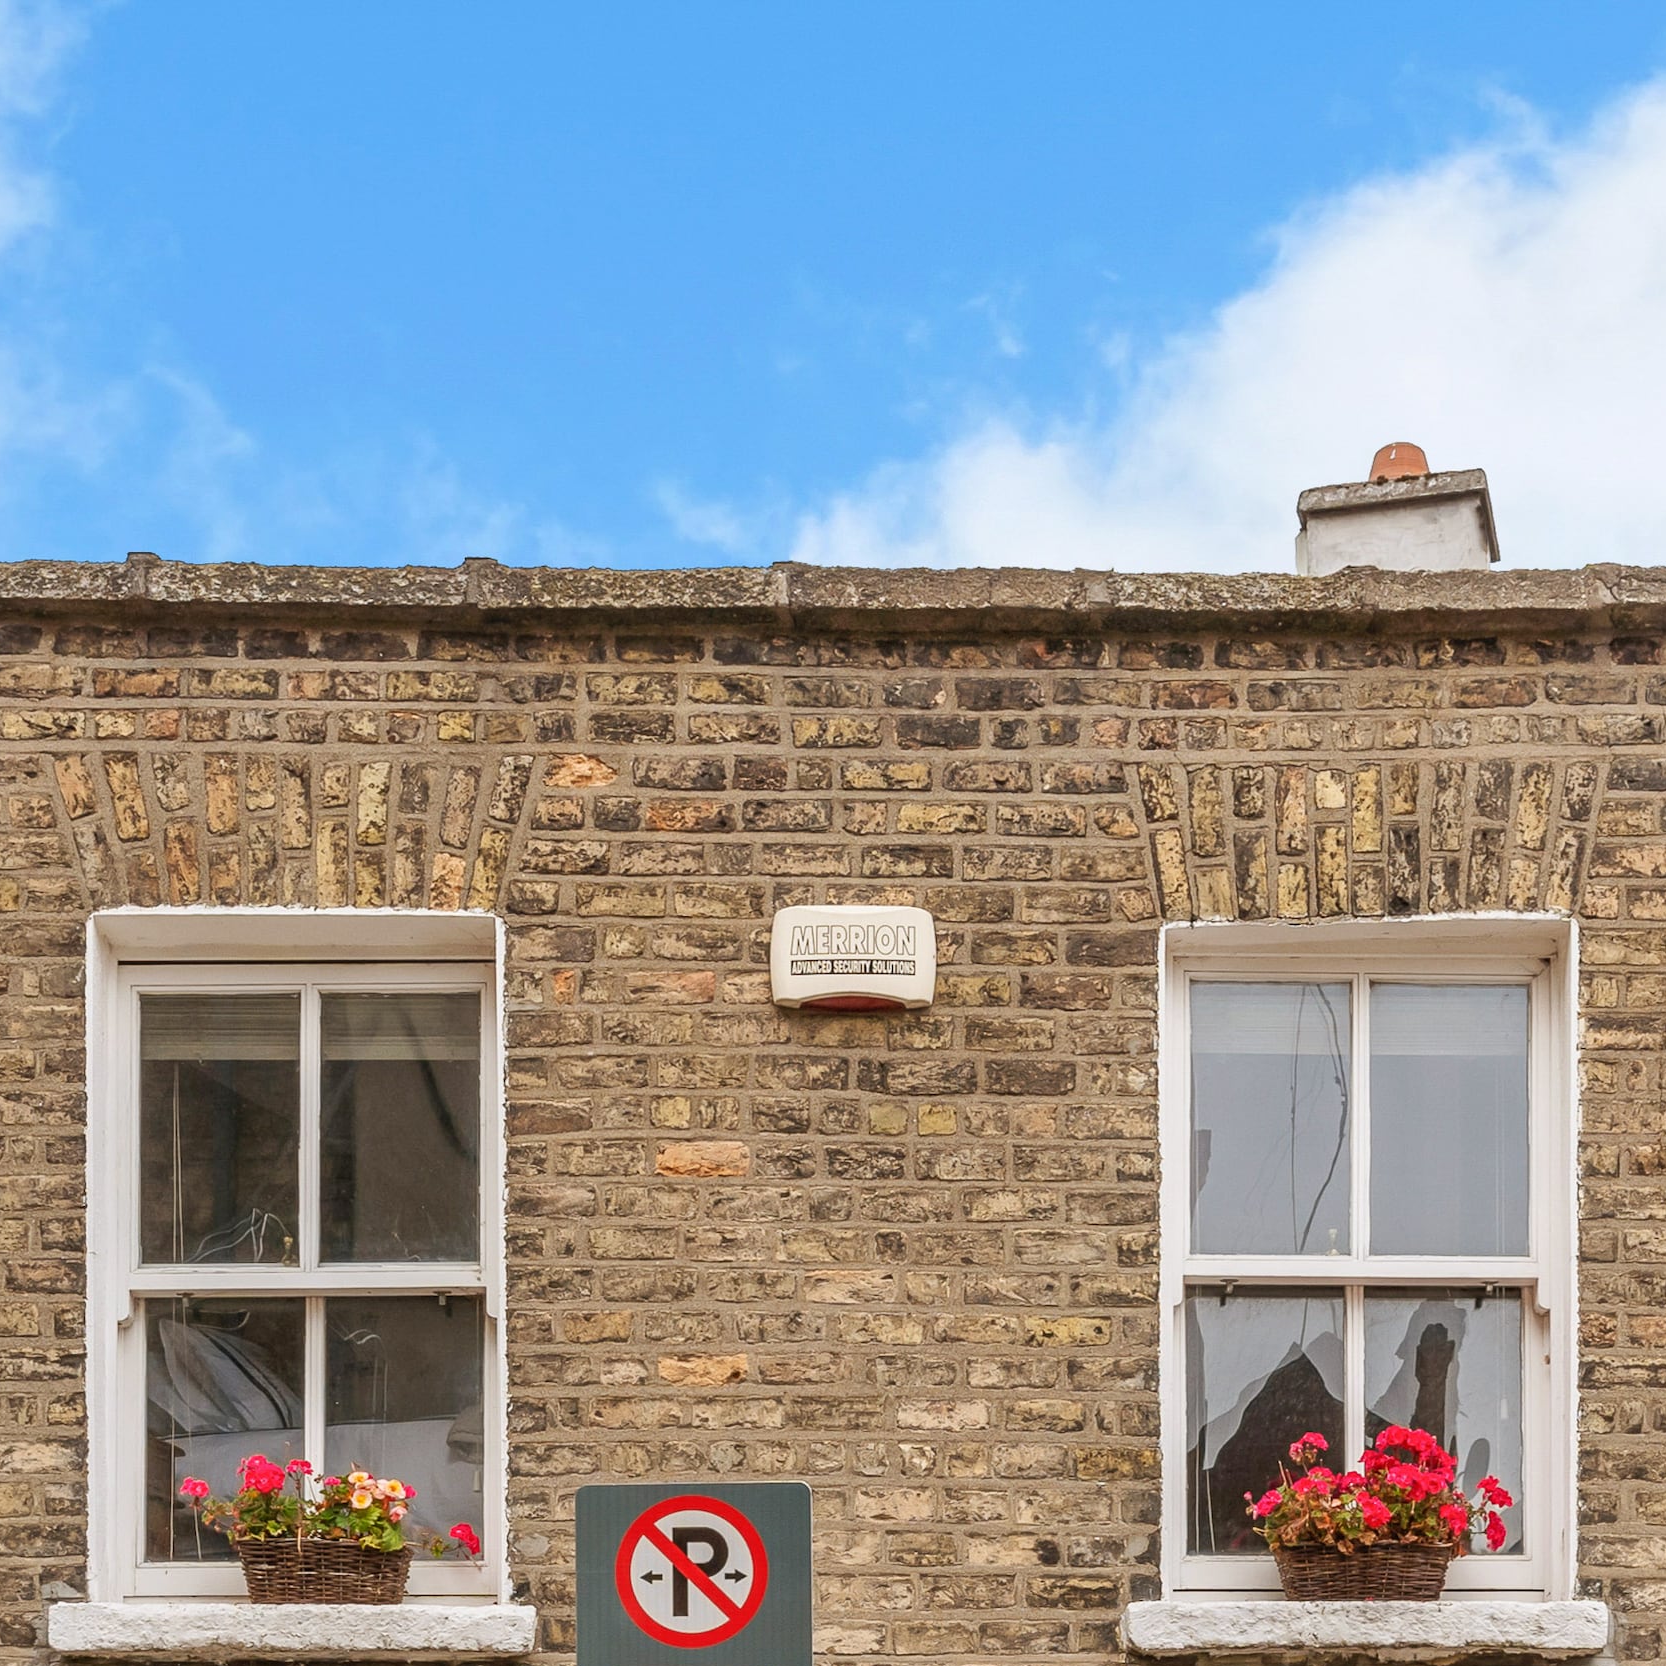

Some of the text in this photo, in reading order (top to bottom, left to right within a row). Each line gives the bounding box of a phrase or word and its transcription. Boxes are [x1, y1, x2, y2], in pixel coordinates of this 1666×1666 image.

[790, 925, 916, 956] MERRION
[792, 960, 915, 974] ADVANCED SECURITY SOLUTIONS
[672, 1526, 729, 1617] P
